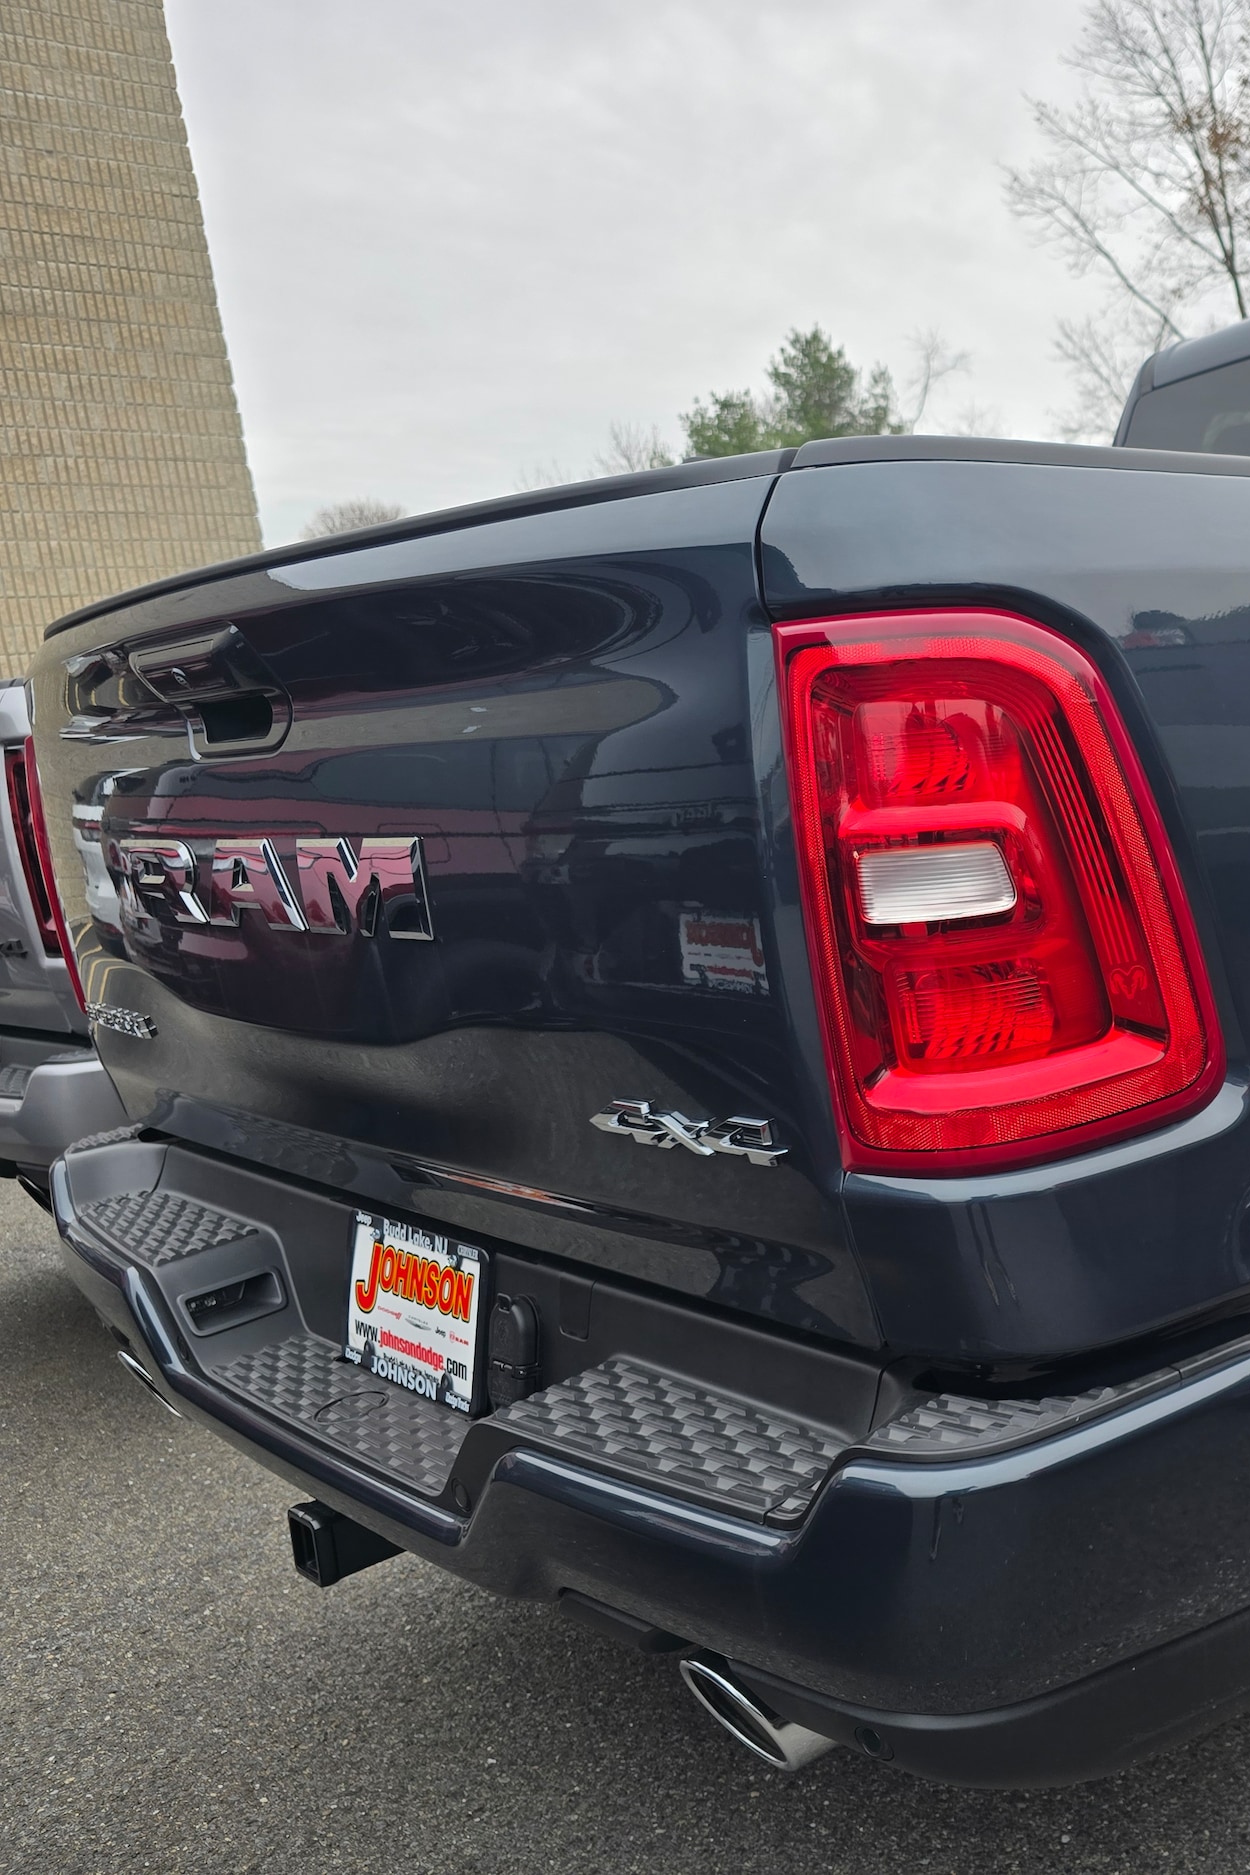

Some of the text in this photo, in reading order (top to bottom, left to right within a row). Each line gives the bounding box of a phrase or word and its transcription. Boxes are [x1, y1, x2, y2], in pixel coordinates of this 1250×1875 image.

[119, 837, 434, 941] RAM
[383, 1218, 407, 1241] Budd
[408, 1225, 433, 1251] Lake,
[434, 1234, 449, 1255] NJ
[355, 1242, 475, 1324] JOHNSON
[354, 1319, 468, 1381] www.johnsondodge.com
[370, 1356, 438, 1401] JOHNSON
